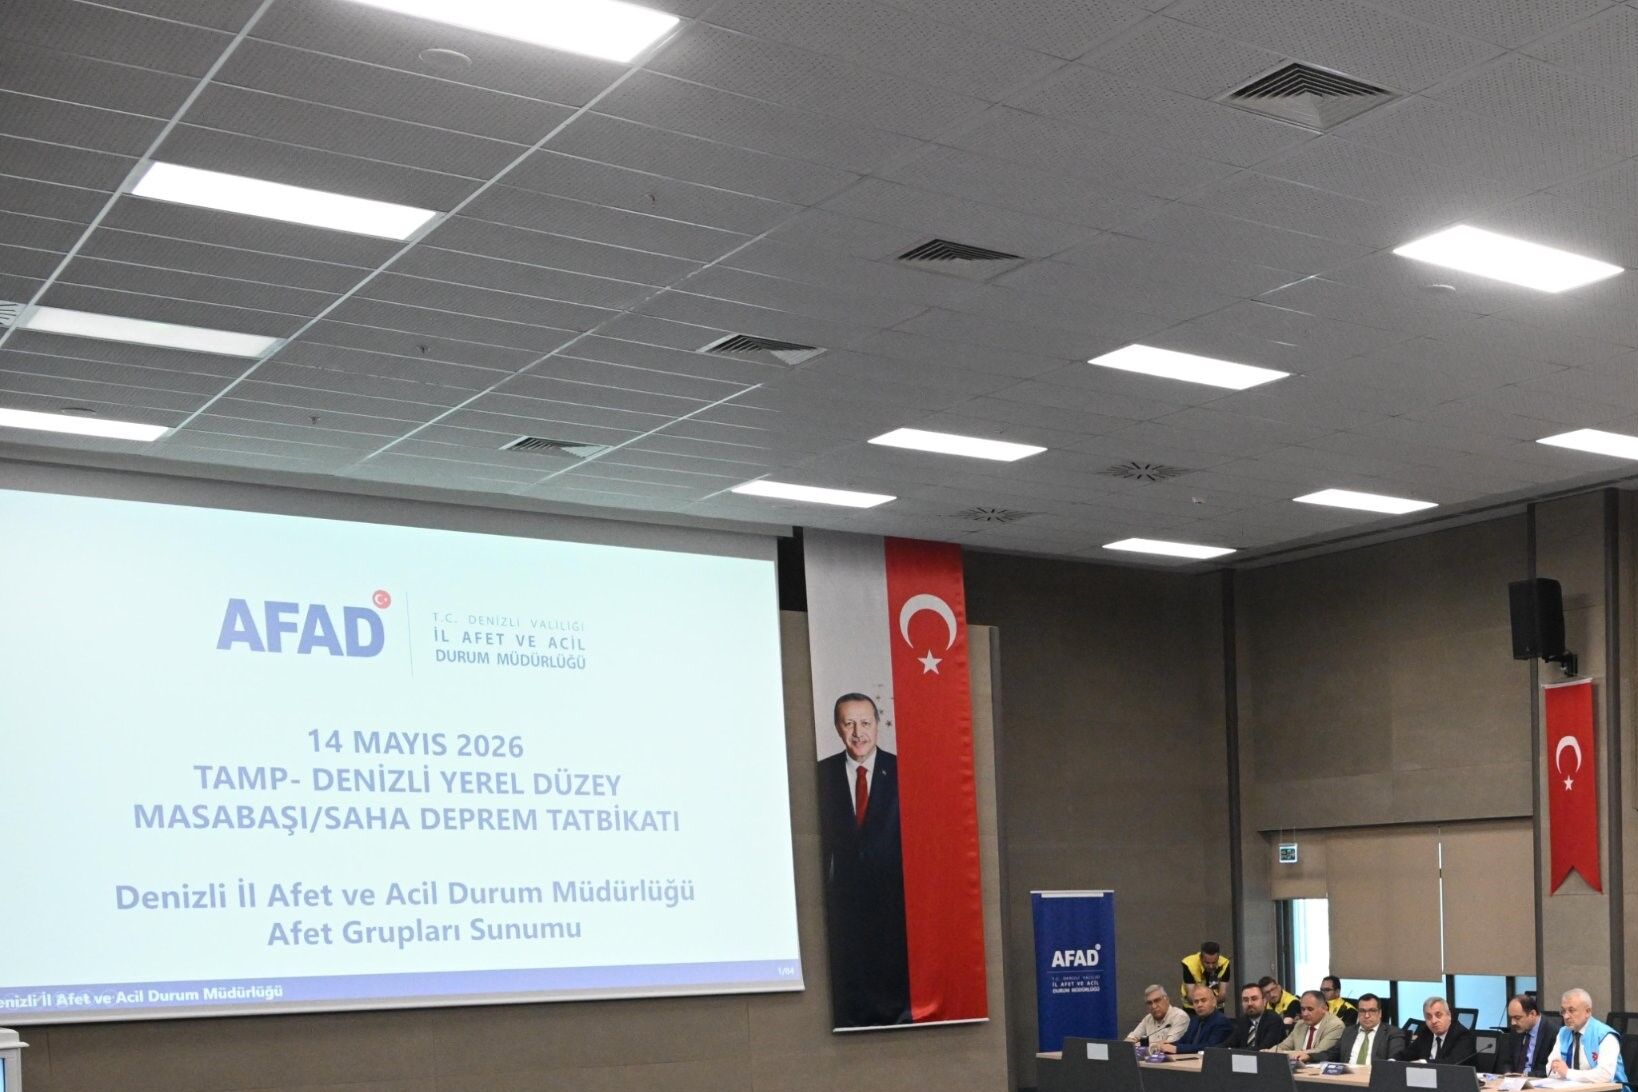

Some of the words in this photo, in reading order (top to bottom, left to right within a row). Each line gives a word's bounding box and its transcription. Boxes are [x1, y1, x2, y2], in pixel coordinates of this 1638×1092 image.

[216, 597, 386, 659] AFAD
[433, 612, 458, 624] T.C.
[468, 614, 520, 628] DENİZLİ
[434, 626, 450, 642] İL
[462, 631, 505, 646] AFET
[515, 633, 537, 648] VE
[548, 635, 586, 651] ACİL
[435, 649, 490, 665] DURUM
[497, 650, 587, 670] MÜDÜRLÜĞÜ
[308, 728, 343, 753] 14
[353, 730, 448, 756] MAYIS
[456, 733, 525, 758] 2026
[193, 764, 301, 791] TAMP-
[312, 763, 431, 793] DENİZLİ
[440, 770, 525, 795] YEREL
[533, 767, 621, 797] DÜZEY
[133, 803, 411, 837] MASABAŞI/SAHA
[420, 806, 538, 831] DEPREM
[546, 803, 680, 833] TATBİKATI
[115, 881, 227, 911] Denizli
[238, 877, 256, 908] İl
[267, 881, 334, 908] Afet
[341, 887, 376, 907] ve
[385, 880, 438, 906] Acil
[448, 880, 543, 905] Durum
[552, 878, 695, 909] Müdürlüğü
[267, 920, 334, 947] Afet
[342, 917, 460, 950] Grupları
[470, 917, 582, 942] Sunumu
[1051, 949, 1099, 968] AFAD
[56, 992, 91, 1007] Afet
[94, 994, 112, 1005] ve
[115, 990, 144, 1004] Acil
[149, 989, 200, 1003] Durum
[203, 984, 284, 1002] Müdürlüğü
